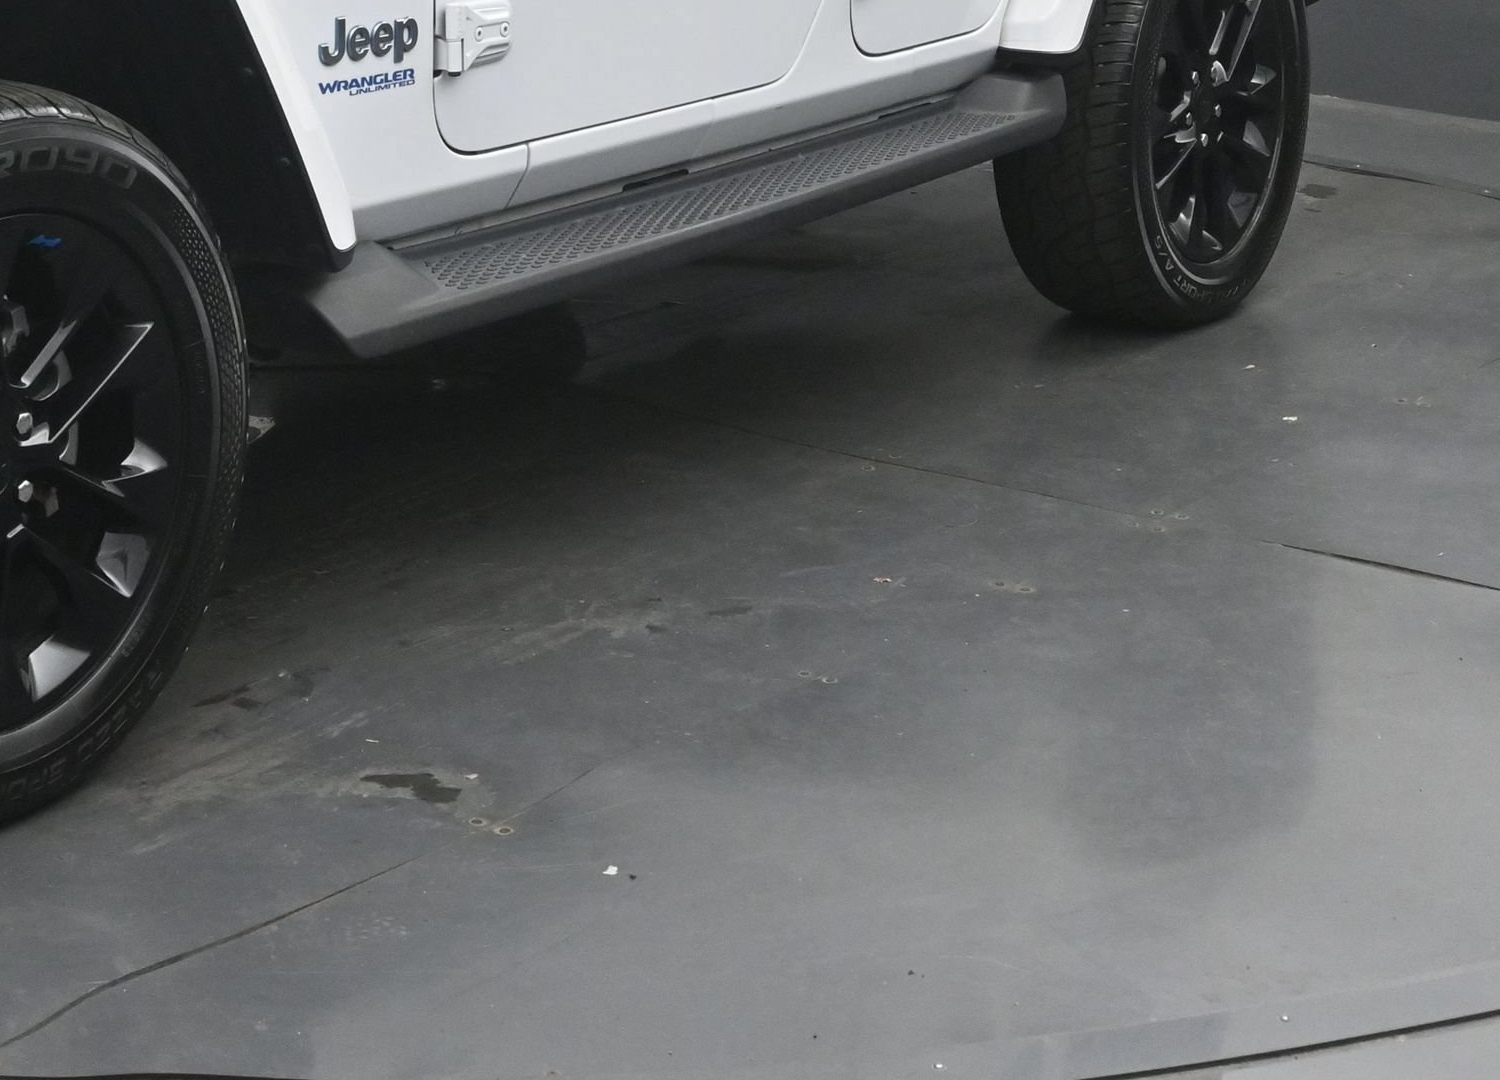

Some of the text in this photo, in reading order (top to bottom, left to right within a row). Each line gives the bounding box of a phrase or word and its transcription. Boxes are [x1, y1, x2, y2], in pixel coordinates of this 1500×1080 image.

[318, 16, 419, 67] Jeep
[318, 68, 415, 95] WRANGLER
[349, 77, 416, 96] UNLIMITED
[1154, 235, 1175, 271] A/S
